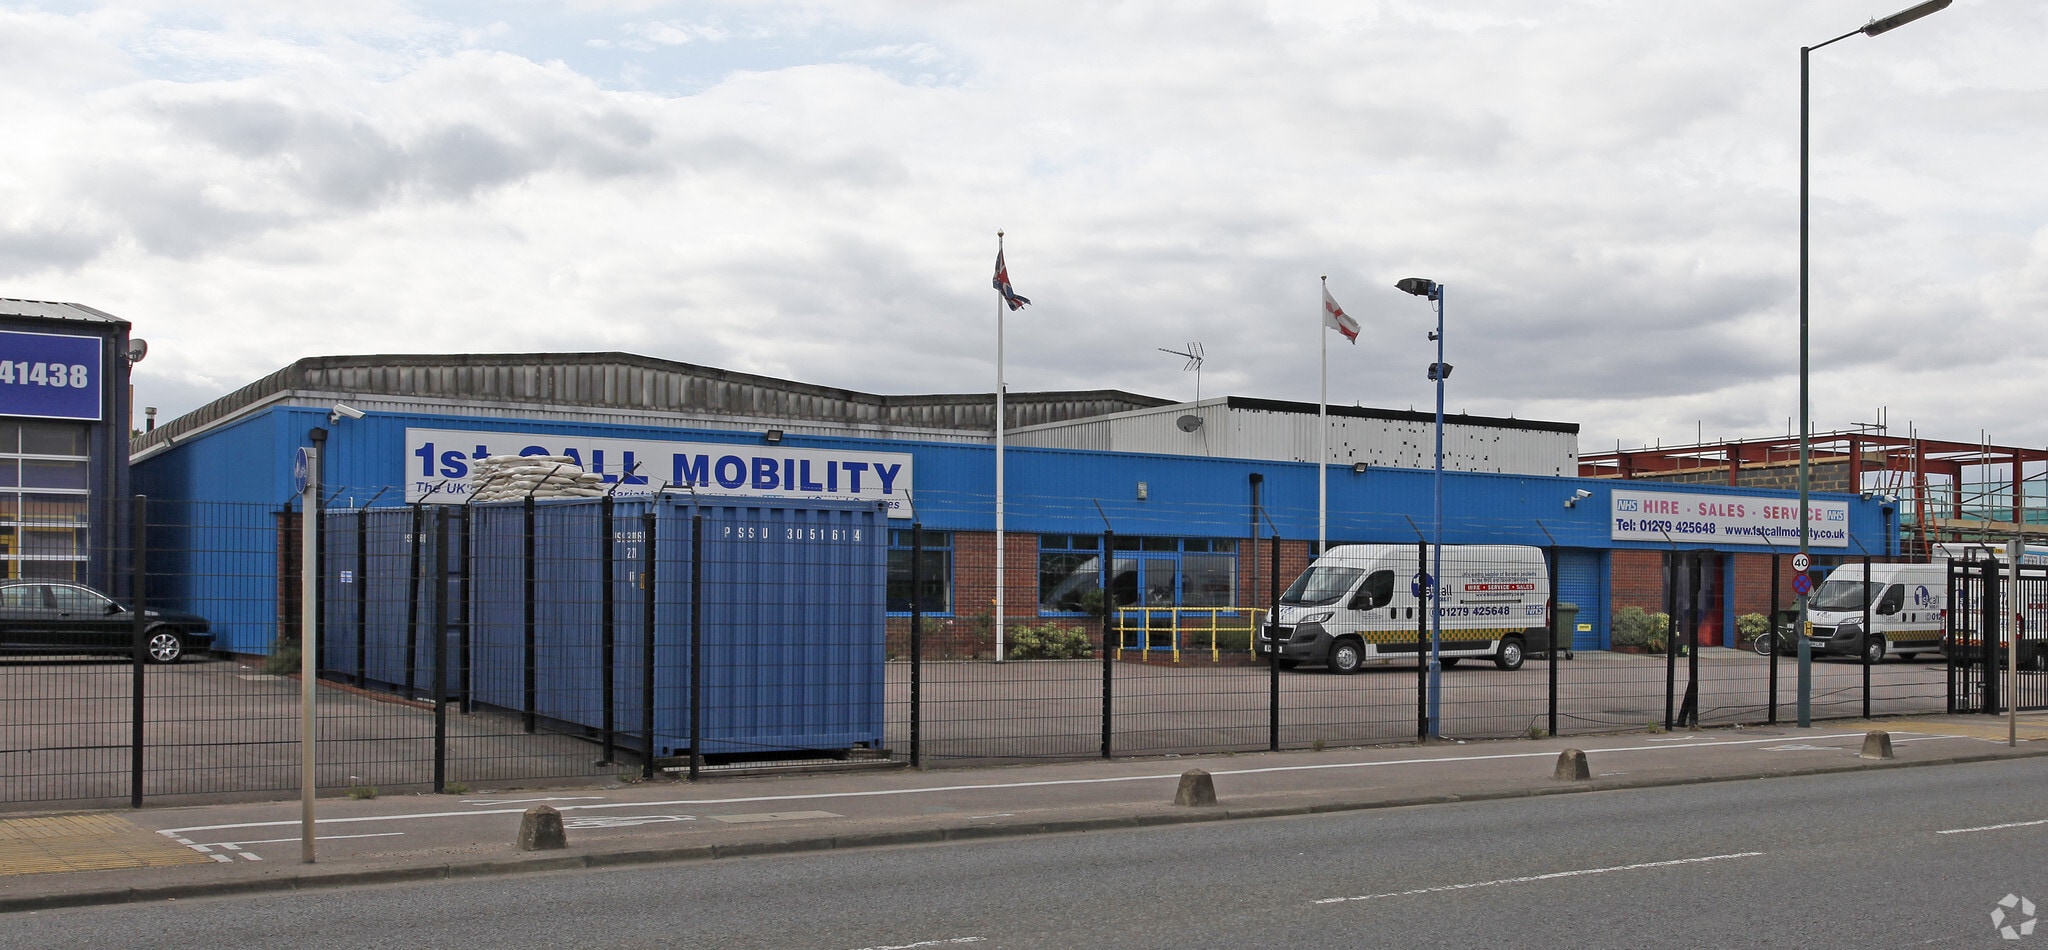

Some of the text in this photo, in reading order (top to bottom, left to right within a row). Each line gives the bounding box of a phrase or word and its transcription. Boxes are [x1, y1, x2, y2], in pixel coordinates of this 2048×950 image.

[0, 360, 88, 389] 41438
[518, 446, 649, 485] ALL
[673, 453, 902, 494] MOBILITY
[416, 482, 440, 494] The
[447, 483, 473, 495] UK'
[1617, 499, 1844, 521] NHS HIRE SALES SERVCE NHS
[724, 526, 768, 539] PSSU
[1616, 518, 1636, 532] Tel:
[1640, 519, 1672, 533] 01279
[1675, 521, 1716, 535] 425648
[1794, 558, 1808, 567] 40
[1440, 606, 1510, 617] 01279 425648
[1526, 604, 1543, 615] NHS
